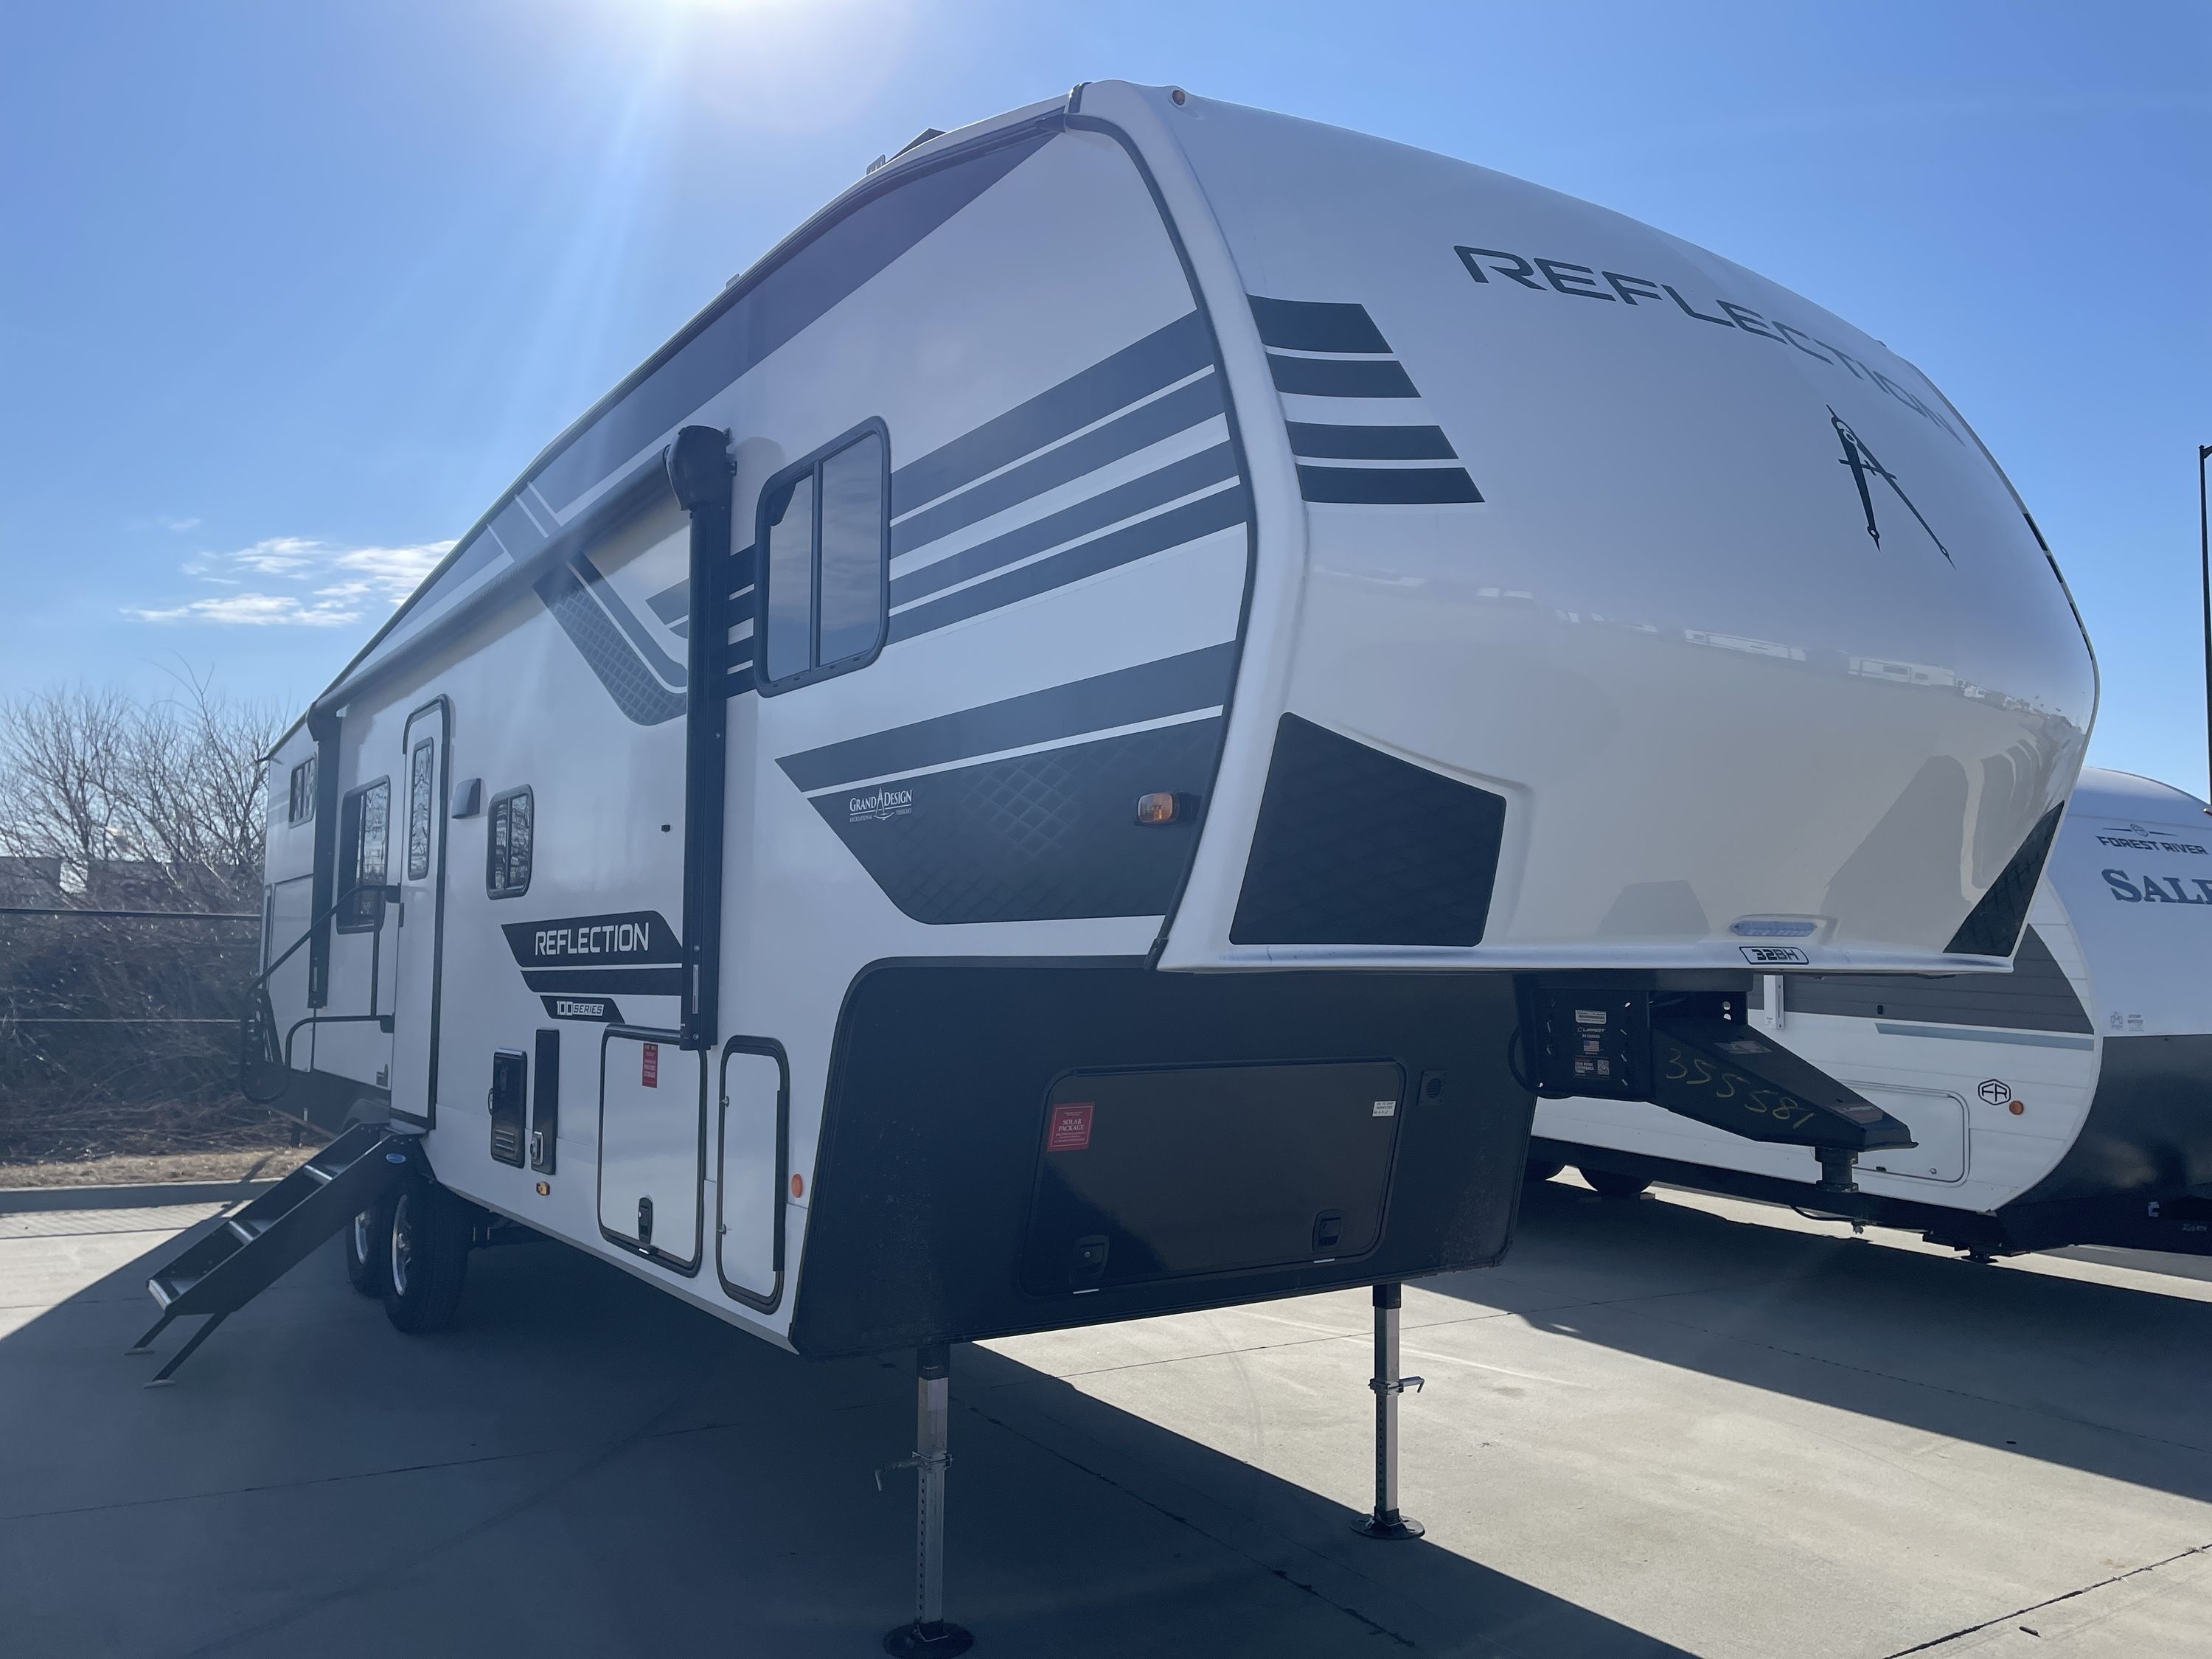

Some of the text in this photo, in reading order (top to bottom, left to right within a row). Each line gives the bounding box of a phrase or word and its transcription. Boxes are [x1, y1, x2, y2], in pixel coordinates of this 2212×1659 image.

[1454, 245, 1966, 447] REFLECTION
[849, 789, 913, 812] GRAND DESIGN
[2096, 835, 2209, 855] FOREST RIVER
[535, 922, 649, 956] REFLECTION
[1751, 949, 1800, 961] 32BH
[557, 1001, 604, 1016] 100 SERIES
[1062, 1118, 1082, 1126] SOLAR
